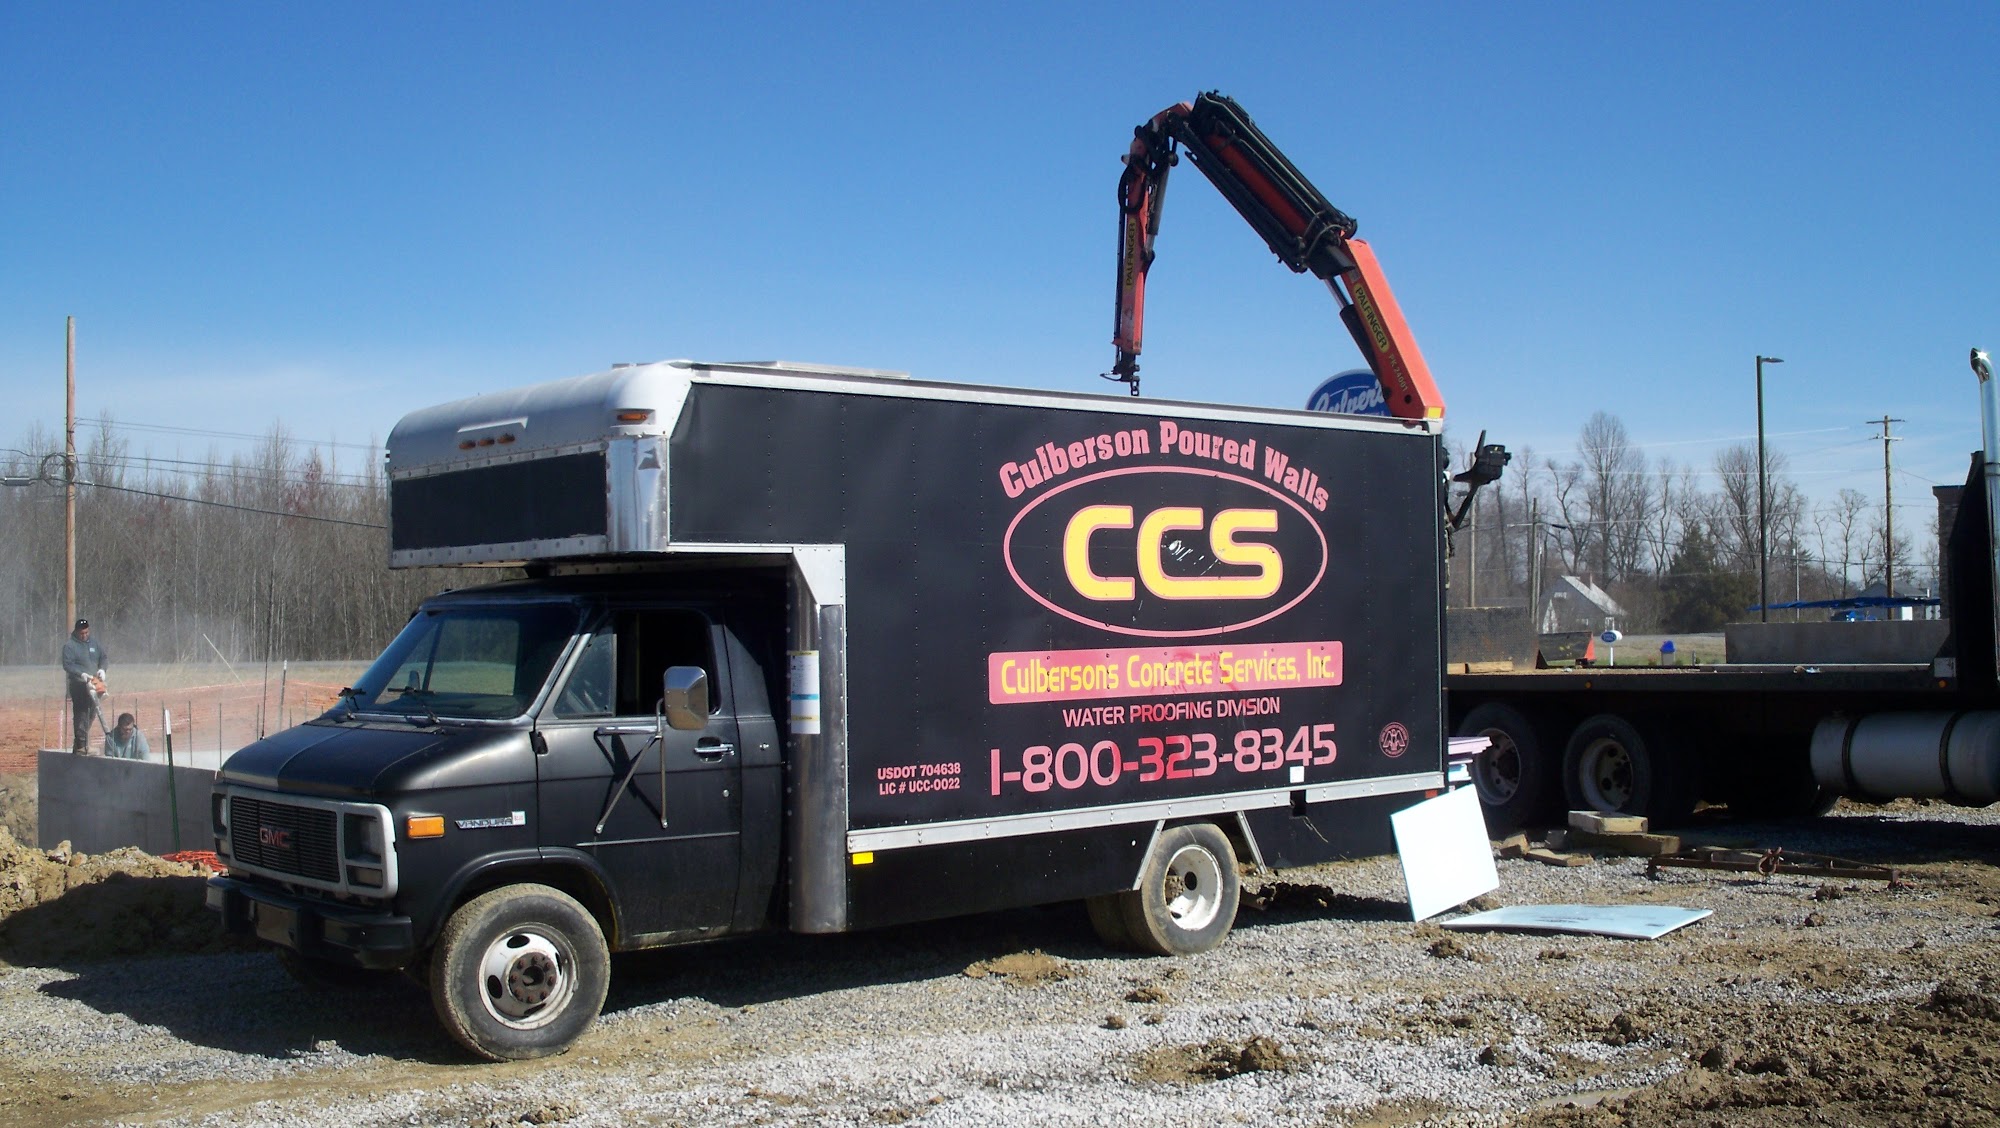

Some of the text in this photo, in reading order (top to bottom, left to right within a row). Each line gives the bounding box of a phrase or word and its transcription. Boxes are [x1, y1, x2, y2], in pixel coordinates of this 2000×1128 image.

[1355, 286, 1388, 349] PALFINGER
[999, 420, 1329, 512] Culberson Poured Walls
[1063, 505, 1283, 601] CCS
[1000, 650, 1335, 695] Culbersons Concrete Services, Inc.
[1062, 696, 1280, 728] WATER PROOFING DIVISION
[877, 762, 961, 780] USDOT 704638
[990, 723, 1337, 795] 1-800-323-8345
[879, 778, 961, 796] LIC # UCC-0022
[259, 827, 290, 848] GMC
[457, 817, 513, 828] VANDURA
